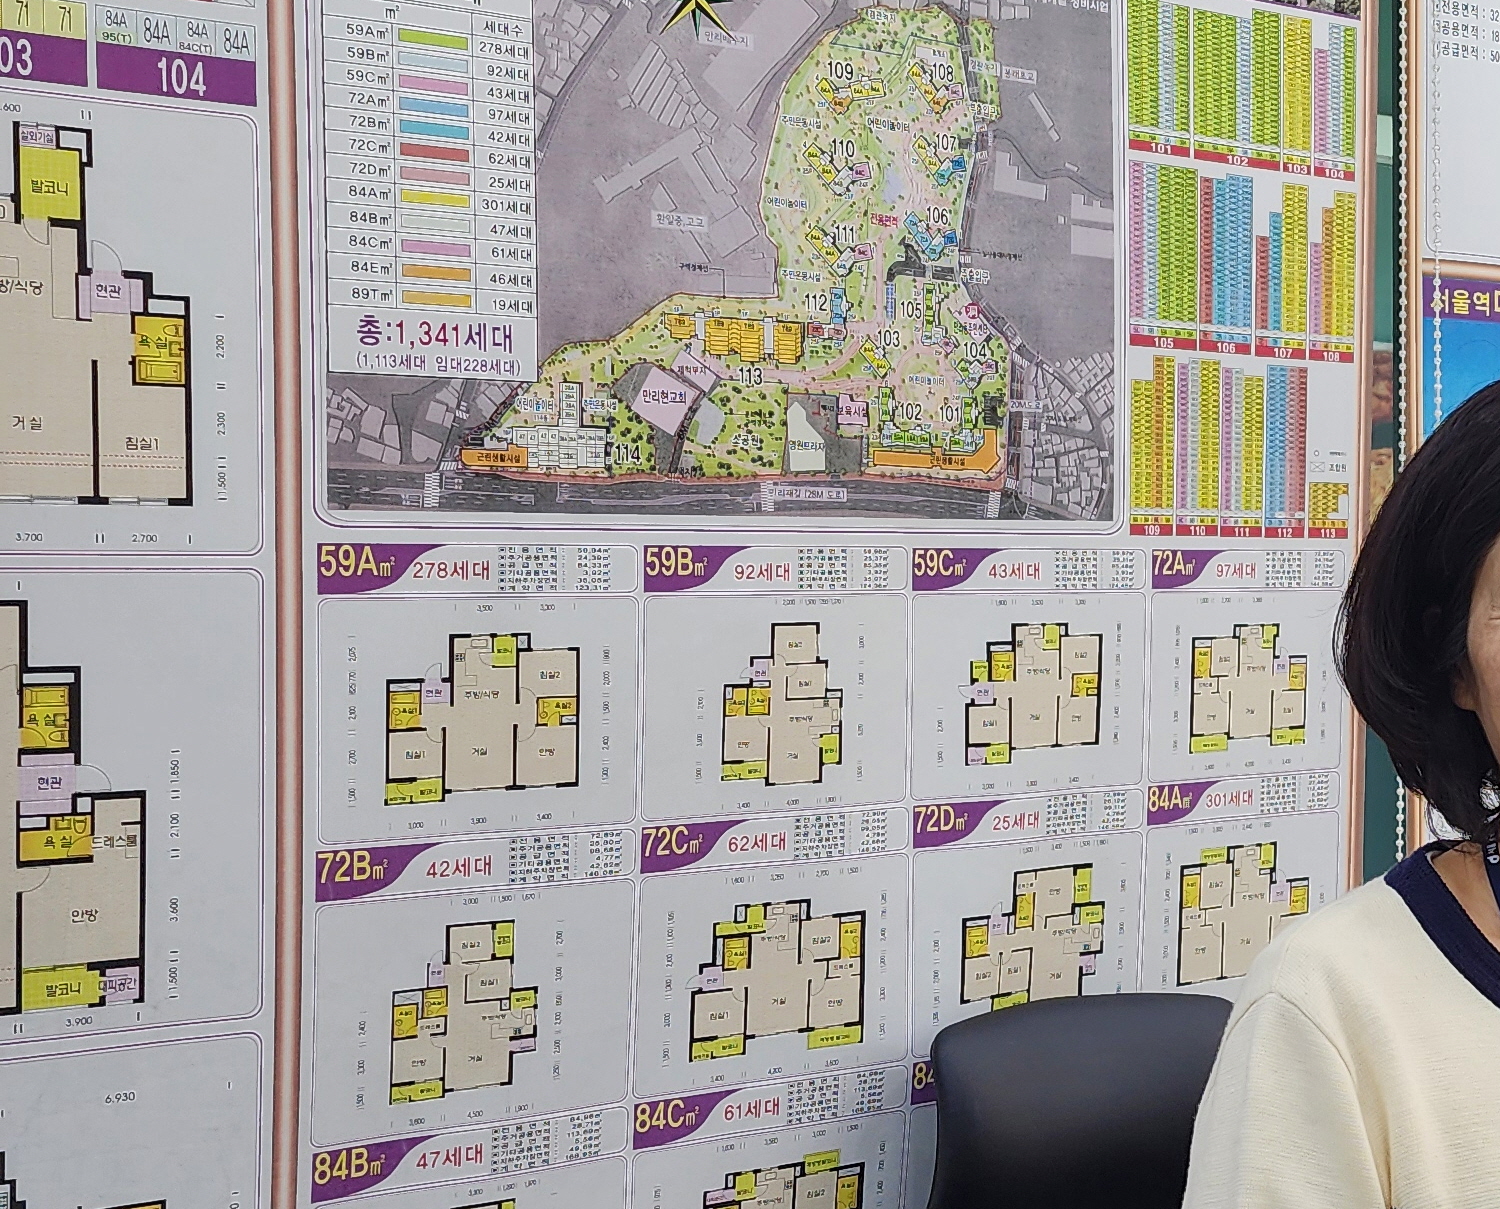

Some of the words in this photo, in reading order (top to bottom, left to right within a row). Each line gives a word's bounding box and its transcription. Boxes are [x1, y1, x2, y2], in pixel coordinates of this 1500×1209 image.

[105, 9, 127, 28] 84A
[143, 17, 171, 45] 84A
[187, 21, 209, 38] 84A
[223, 28, 250, 55] 84A
[483, 21, 523, 37] 세대수
[479, 41, 529, 60] 278세대
[158, 56, 206, 97] 104
[487, 65, 529, 82] 92세대
[827, 61, 854, 80] 109
[932, 63, 955, 82] 108
[487, 87, 530, 104] 43세대
[488, 109, 530, 126] 97세대
[488, 131, 530, 147] 42세대
[832, 139, 855, 158] 110
[935, 133, 956, 152] 107
[488, 152, 531, 169] 62세대
[489, 176, 531, 193] 25세대
[482, 199, 531, 216] 301세대
[926, 206, 949, 226] 106
[490, 225, 532, 240] 47세대
[835, 224, 856, 244] 111
[492, 247, 532, 263] 61세대
[490, 273, 532, 288] 46세대
[95, 283, 121, 299] 현관
[492, 300, 532, 314] 19세대
[804, 292, 827, 312] 112
[900, 300, 922, 320] 105
[357, 315, 513, 354] 총:1,341세대
[877, 328, 901, 349] 103
[963, 341, 987, 361] 104
[356, 351, 426, 372] (1,113세대
[436, 356, 521, 376] 임대228세대)
[738, 365, 763, 387] 113
[641, 388, 687, 405] 만리현교회
[899, 401, 922, 422] 102
[939, 404, 961, 424] 101
[125, 437, 159, 450] 침실1
[615, 443, 641, 465] 114
[412, 559, 491, 581] 278세대
[734, 562, 791, 582] 92세대
[988, 561, 1041, 580] 43세대
[1216, 562, 1257, 580] 97세대
[37, 776, 62, 791] 현관
[1205, 792, 1254, 809] 301세대
[992, 810, 1040, 831] 25세대
[728, 831, 786, 853] 62세대
[426, 855, 492, 879] 42세대
[71, 909, 99, 923] 안방
[104, 1091, 136, 1105] 6.930
[723, 1096, 780, 1121] 61세대
[415, 1143, 484, 1170] 47세대
